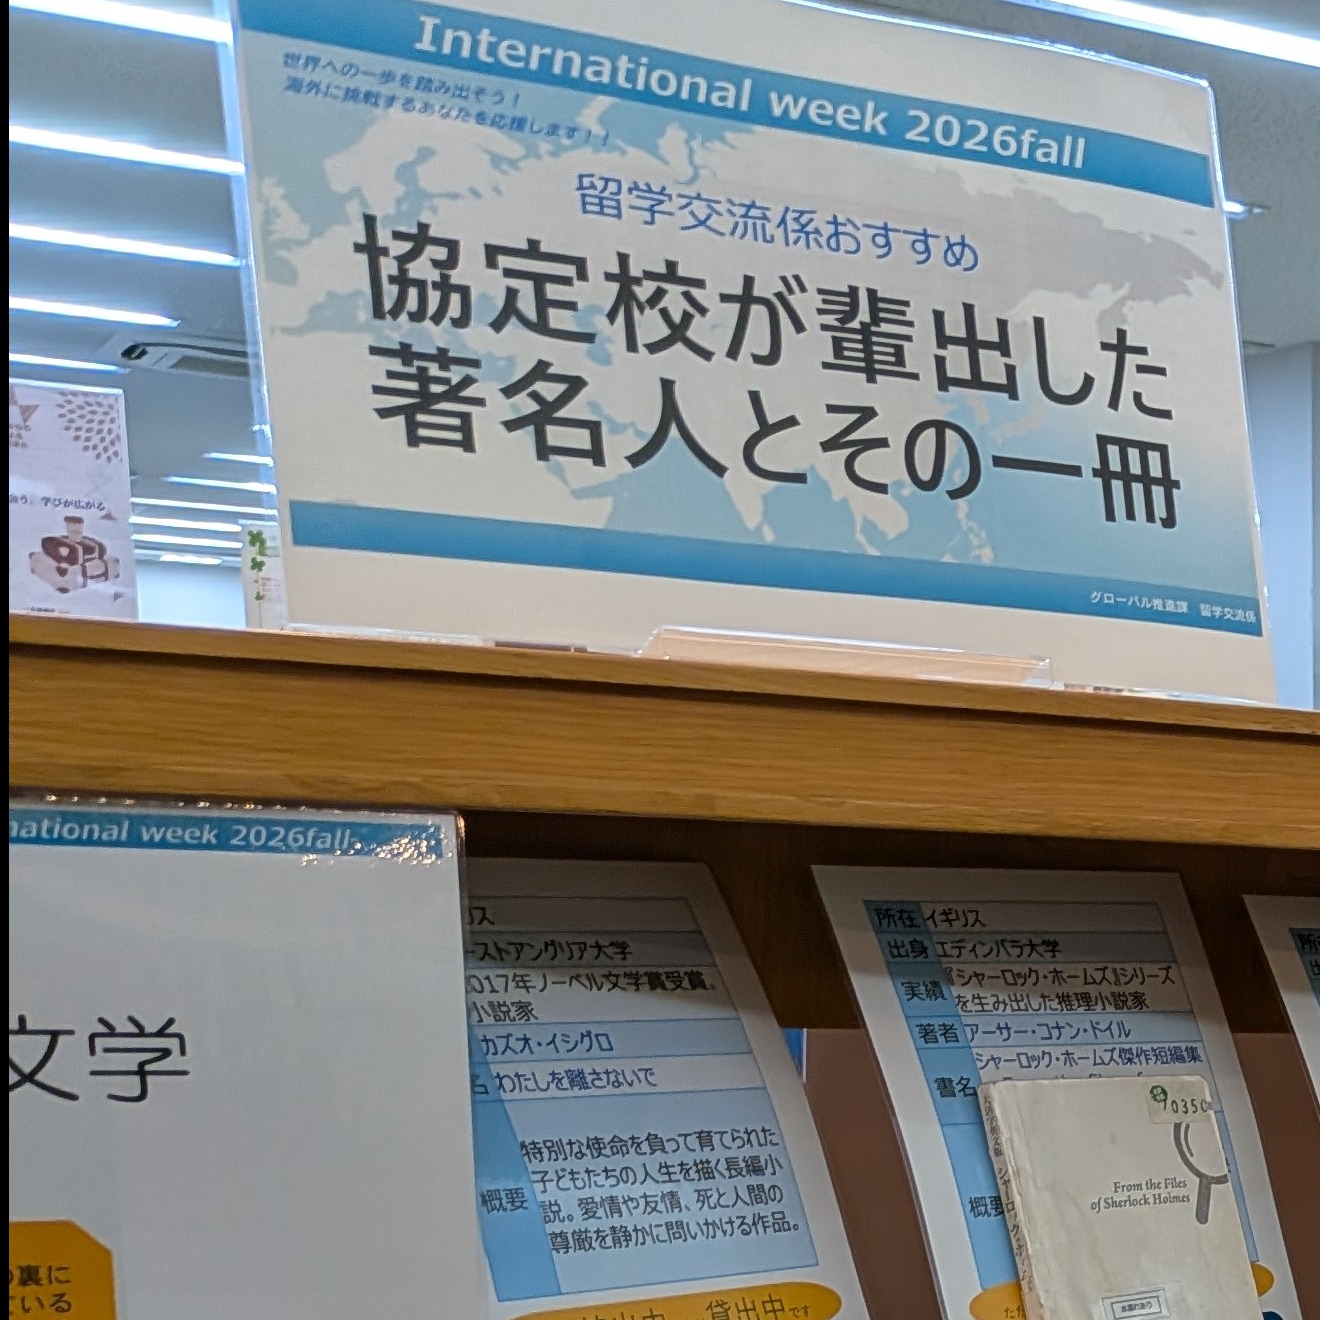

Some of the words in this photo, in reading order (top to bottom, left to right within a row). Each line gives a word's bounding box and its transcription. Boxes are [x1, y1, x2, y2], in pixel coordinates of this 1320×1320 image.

[412, 15, 753, 113] International
[768, 86, 888, 138] week
[903, 106, 1087, 171] 2026fall
[576, 172, 981, 272] 留学交流係おすすめ
[353, 213, 1175, 422] 協定校が輩出した
[368, 343, 1182, 531] 著名人とその一冊
[1091, 591, 1189, 614] グローバル推進課
[1200, 603, 1257, 624] 留学交流係
[140, 824, 218, 846] week
[229, 825, 351, 850] 2026fall
[875, 908, 922, 930] 所在
[925, 908, 987, 929] イギリス
[887, 940, 930, 961] 出身
[936, 938, 1062, 960] エディンバラ大学
[946, 964, 1177, 987] 『シャーロック・ホームズ』シリーズ
[901, 980, 949, 1003] 実績
[956, 991, 1151, 1015] を生み出した推理小説家
[471, 1000, 539, 1024] 小説家
[480, 1031, 615, 1057] カズオ・イシグロ
[915, 1022, 960, 1045] 著者
[968, 1020, 1132, 1044] アーサー・コナン・ドイル
[9, 1014, 191, 1103] 文学
[975, 1045, 1204, 1071] シャーロック・ホームズ傑作短編集
[494, 1065, 659, 1095] わたしを離さないで
[934, 1074, 977, 1099] 書名
[520, 1126, 780, 1163] 特別な使命を負って育てられた
[531, 1157, 785, 1196] 子どもたちの人生を描く長編小
[1113, 1180, 1144, 1194] From
[1146, 1178, 1162, 1191] the
[1164, 1177, 1188, 1190] Files
[481, 1187, 530, 1215] 概要
[541, 1186, 785, 1225] 説。愛情や友情、死と人間の
[1090, 1197, 1102, 1214] of
[1104, 1194, 1151, 1210] Sherlock
[1152, 1191, 1191, 1206] Holmes
[549, 1211, 801, 1256] 尊厳を静かに問いかける作品。
